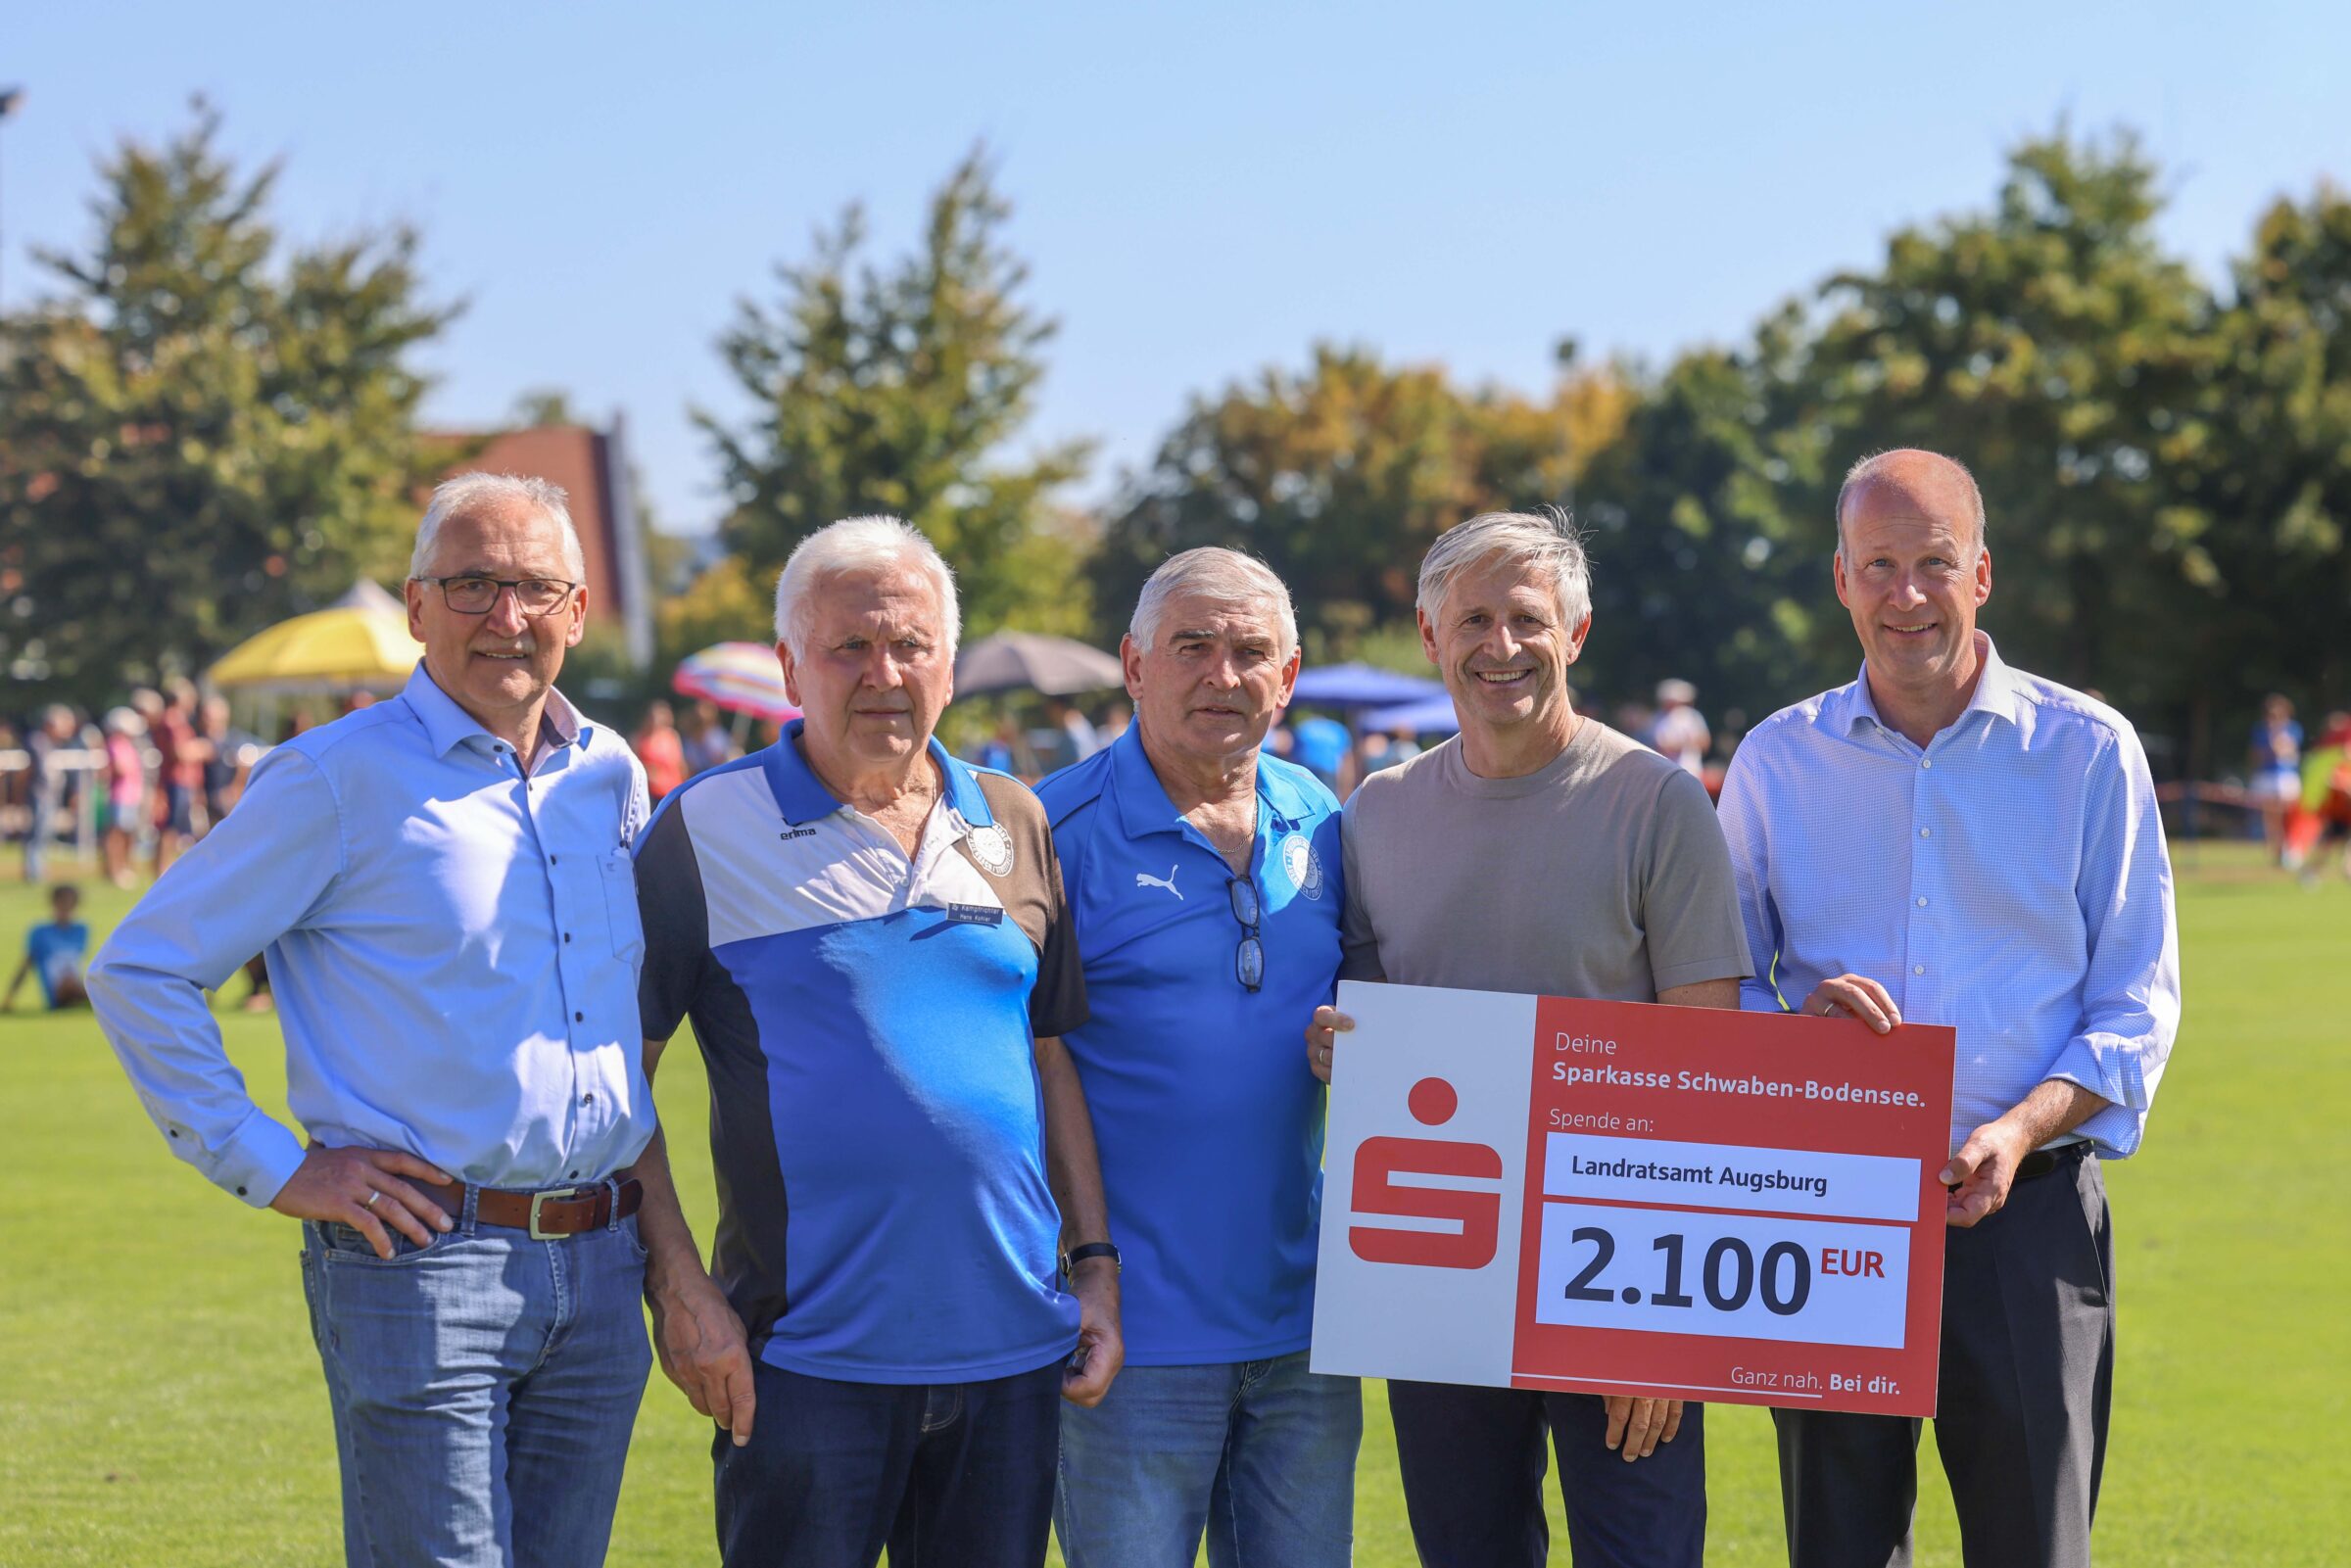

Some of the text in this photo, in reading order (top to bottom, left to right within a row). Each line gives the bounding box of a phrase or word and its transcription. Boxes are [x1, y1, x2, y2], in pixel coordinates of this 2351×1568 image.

[780, 829, 817, 840] erima
[1555, 1031, 1617, 1055] Deine
[1553, 1061, 1927, 1108] Sparkasse Schwaben-Bodensee.
[1549, 1108, 1654, 1132] Spende an:
[1571, 1156, 1828, 1197] Landratsamt Augsburg
[1564, 1226, 1886, 1316] 2.100 EUR
[1730, 1366, 1900, 1396] Ganz nah. Bei dir.
